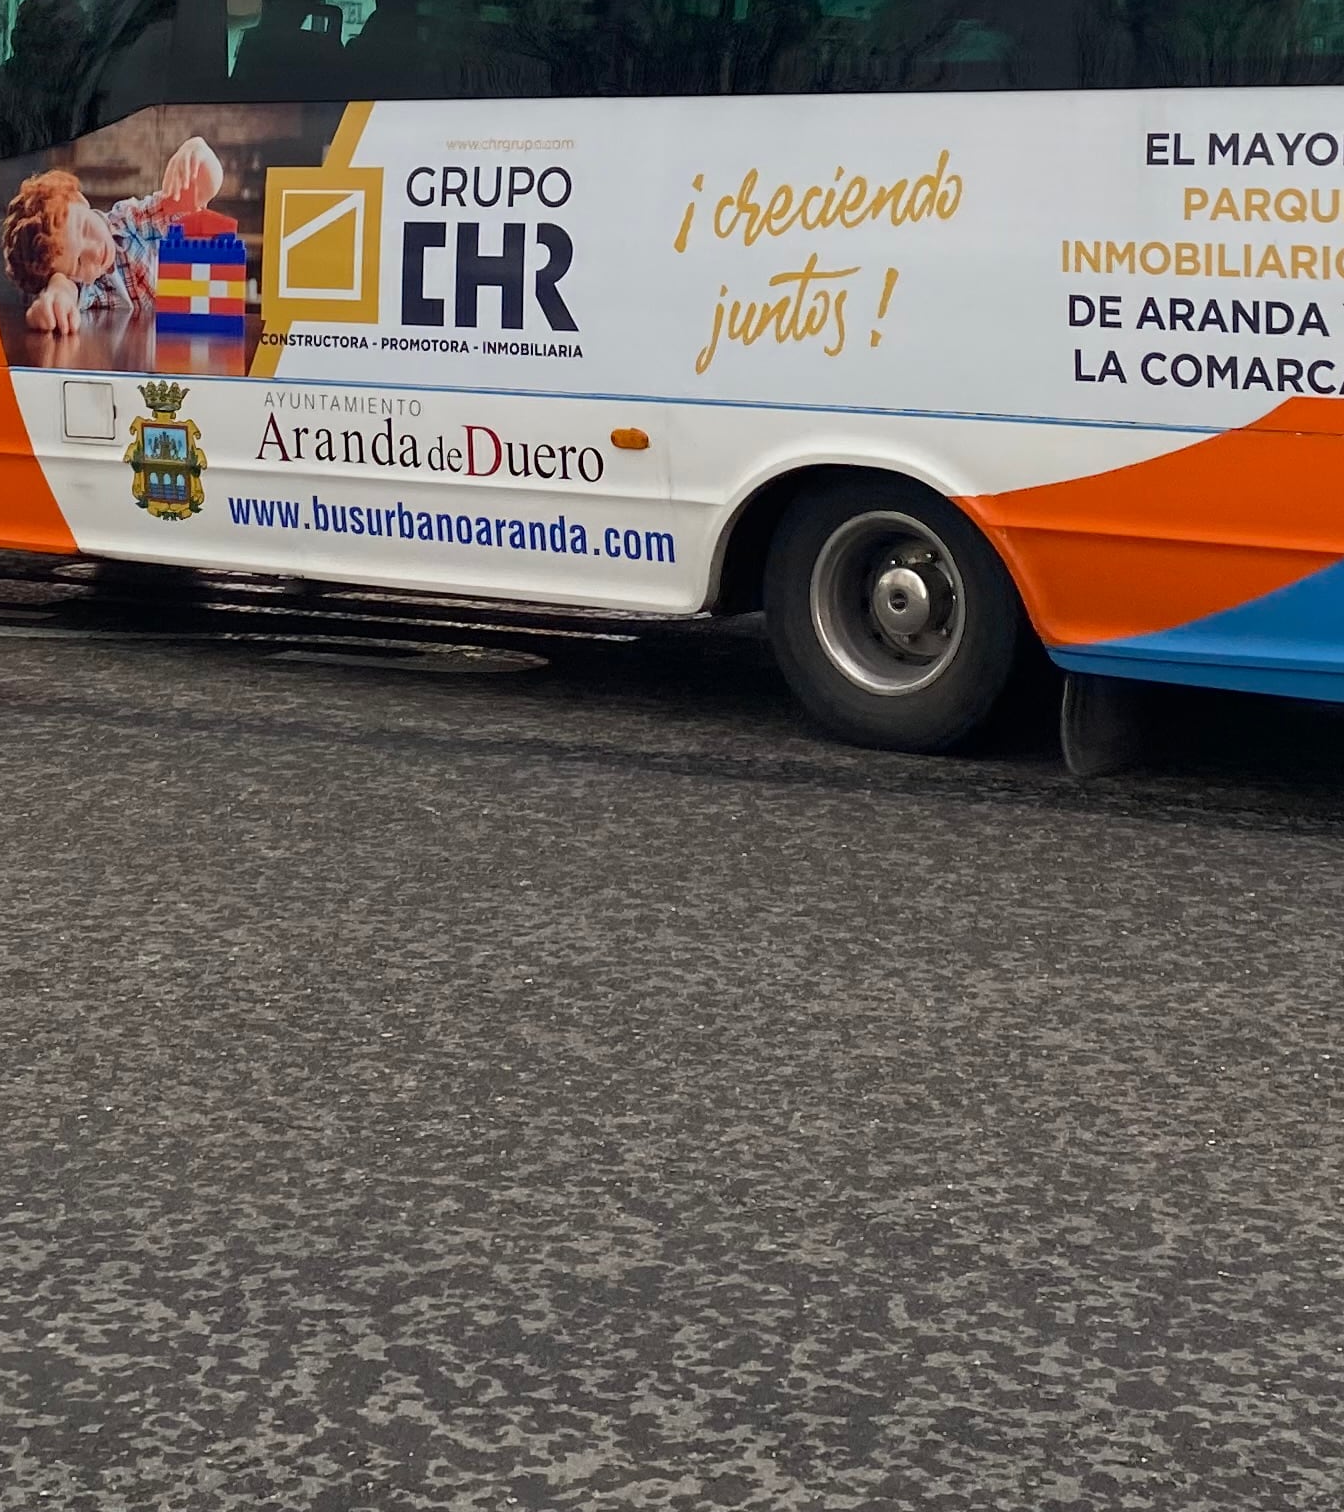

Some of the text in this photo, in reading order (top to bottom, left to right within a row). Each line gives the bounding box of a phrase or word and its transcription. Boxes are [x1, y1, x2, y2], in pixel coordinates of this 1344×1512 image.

[1146, 133, 1195, 166] EL
[406, 166, 572, 208] GRUPO
[401, 221, 579, 332] CHR
[1068, 294, 1122, 328] DE
[1136, 297, 1330, 337] ARANDA
[260, 332, 369, 350] CONSTRUCTORA
[381, 338, 470, 354] PROMOTORA
[482, 341, 583, 358] INMOBILIARIA
[1074, 348, 1127, 384] LA
[264, 391, 423, 417] AYUNTAMIENTO
[256, 412, 604, 482] Aranda de Duero
[228, 495, 677, 564] www.busurbanoaranda.com
